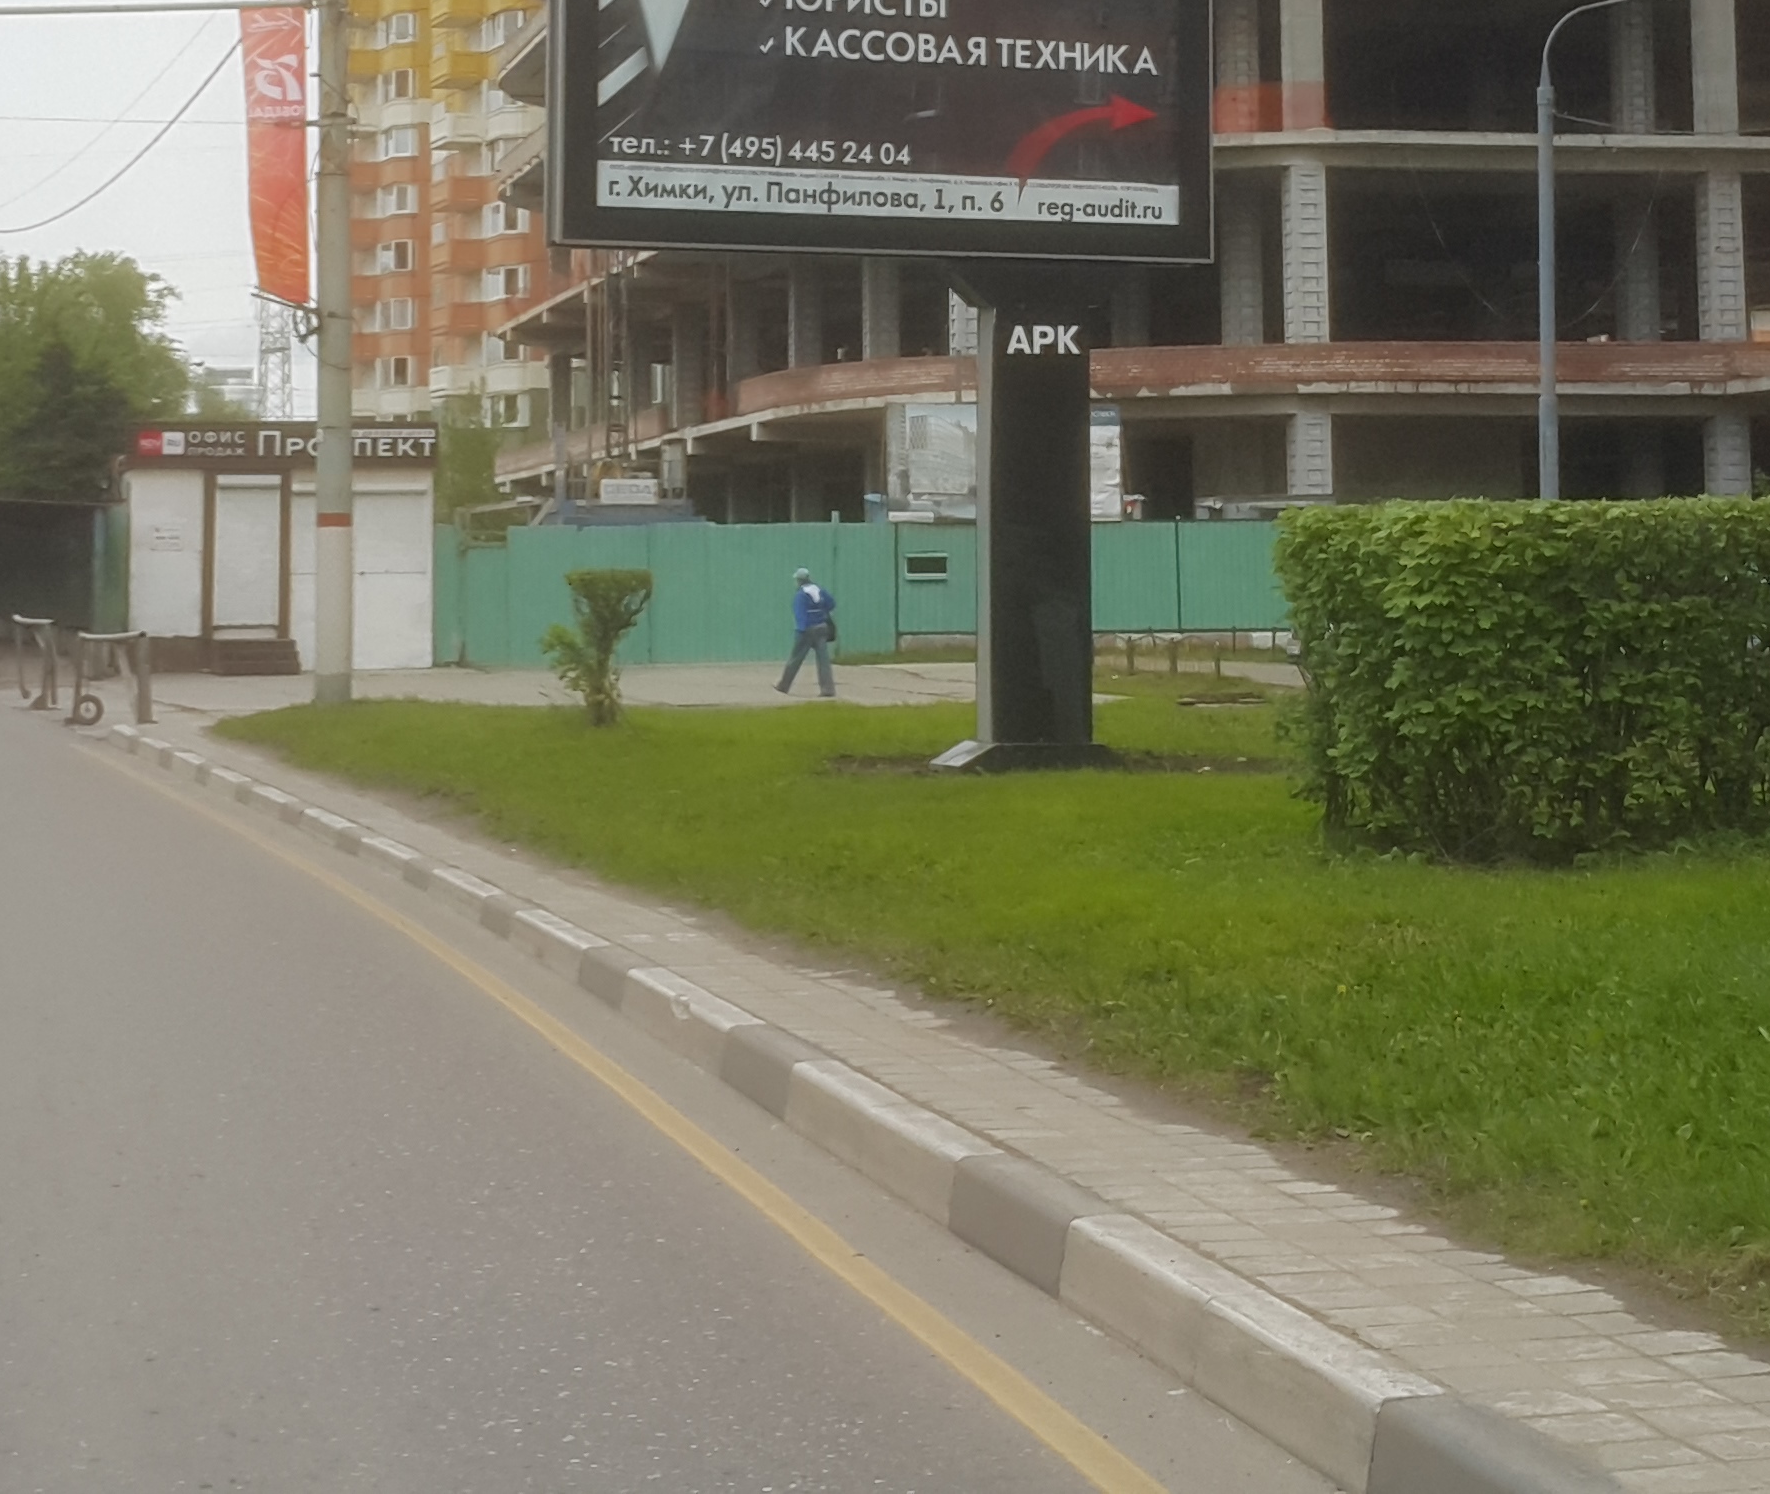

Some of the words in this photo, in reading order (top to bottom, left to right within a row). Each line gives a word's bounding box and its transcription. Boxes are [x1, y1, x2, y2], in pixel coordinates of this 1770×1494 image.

[785, 25, 988, 66] КАССОВАЯ
[996, 37, 1159, 76] ТЕХНИКА
[609, 136, 670, 155] тел.:
[679, 135, 715, 156] +7
[721, 132, 782, 166] (495)
[788, 140, 835, 163] 445
[842, 143, 873, 164] 24
[880, 143, 911, 165] 04
[608, 180, 620, 197] г.
[627, 175, 715, 204] Химки,
[722, 183, 758, 208] ул.
[766, 181, 926, 213] Панфилова,
[933, 189, 954, 213] 1,
[961, 194, 982, 211] п.
[990, 191, 1004, 212] 6
[1037, 198, 1163, 222] reg-audit.ru
[188, 430, 246, 444] ОФИС
[258, 430, 437, 457] ПРОПЕКТ
